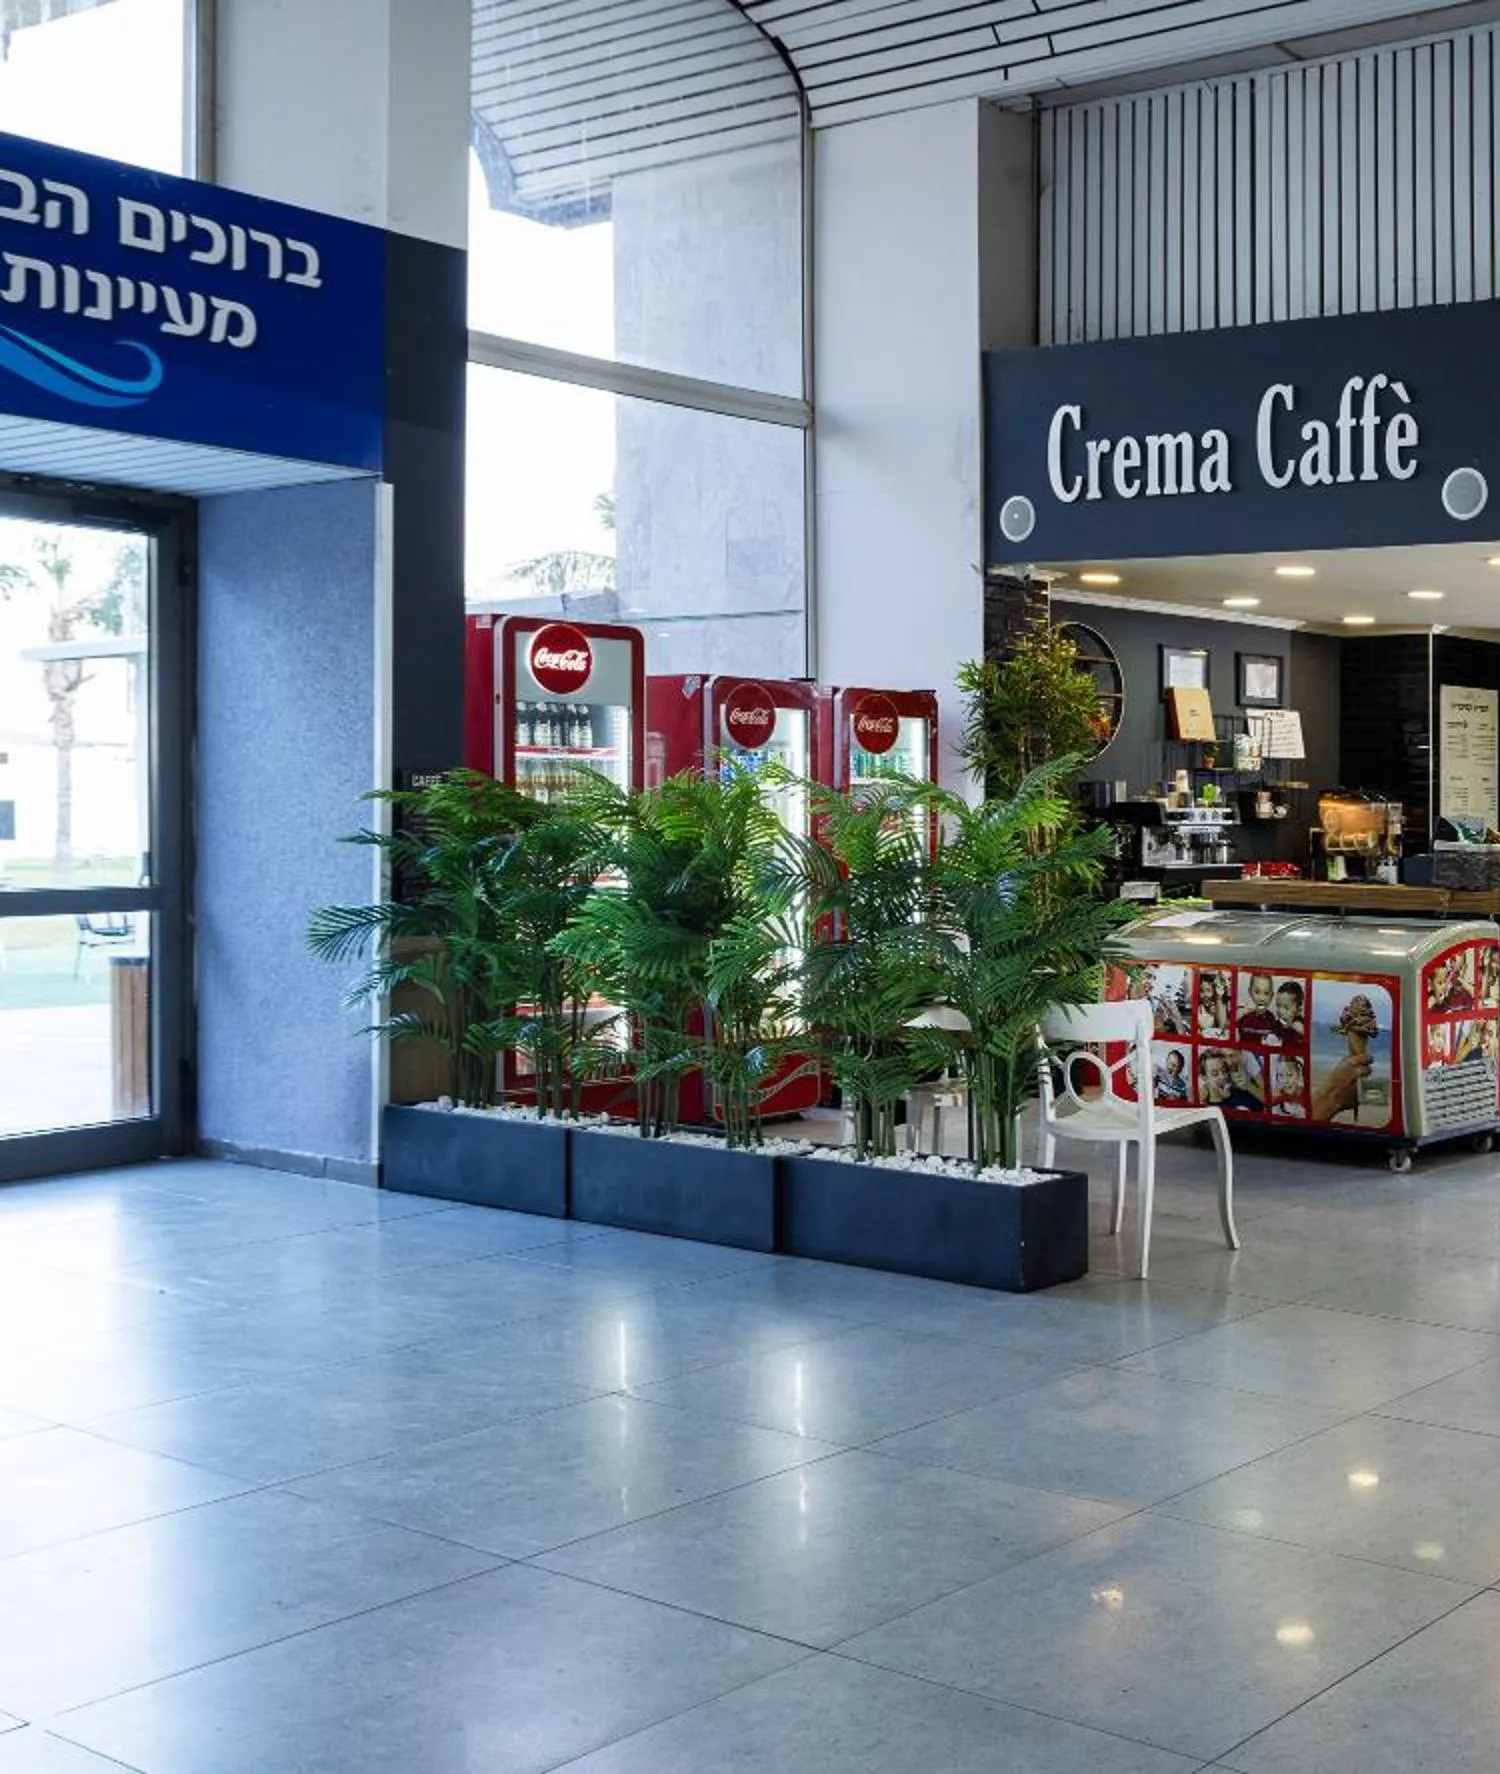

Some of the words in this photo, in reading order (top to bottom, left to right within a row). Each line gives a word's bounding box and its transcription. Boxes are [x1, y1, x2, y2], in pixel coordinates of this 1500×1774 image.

[118, 197, 322, 288] ברוכים
[2, 251, 257, 348] מעיינות
[1047, 404, 1233, 503] Crema
[1257, 373, 1420, 489] Caffè
